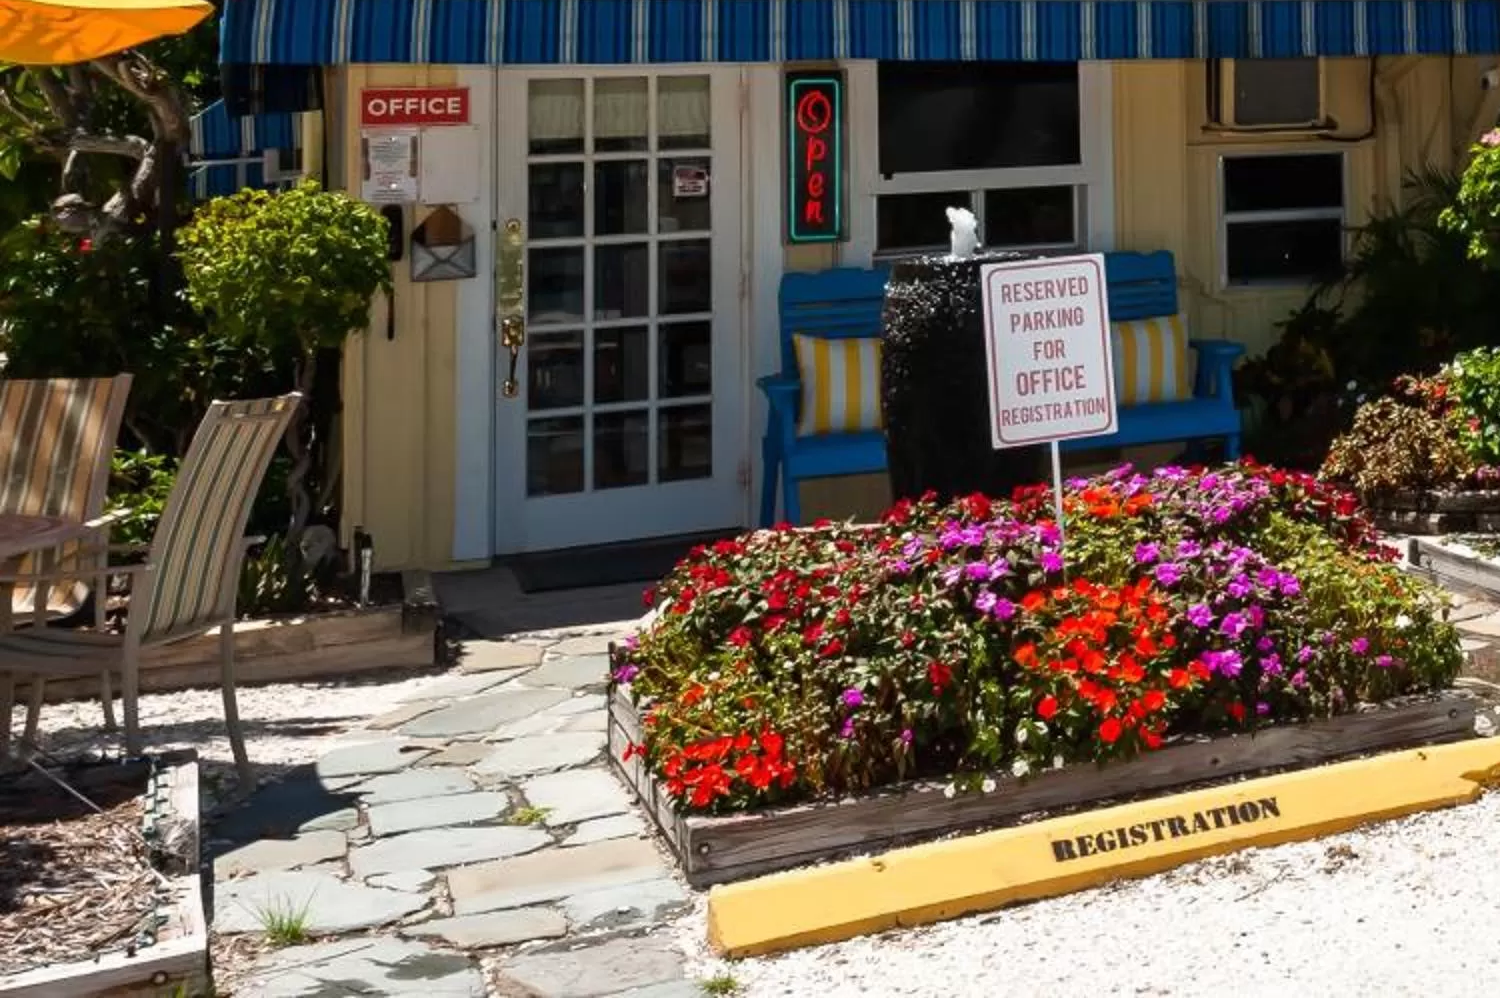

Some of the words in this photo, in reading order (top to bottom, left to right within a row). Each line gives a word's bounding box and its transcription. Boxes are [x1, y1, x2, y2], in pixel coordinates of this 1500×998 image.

[367, 97, 462, 116] OFFICE
[797, 89, 832, 223] Open
[1001, 276, 1089, 303] RESERVED
[1010, 306, 1085, 333] PARKING
[1033, 339, 1066, 360] FOR
[1016, 365, 1086, 397] OFFICE
[1001, 397, 1106, 426] REGISTRATION
[1050, 796, 1281, 862] REGISTRATION
